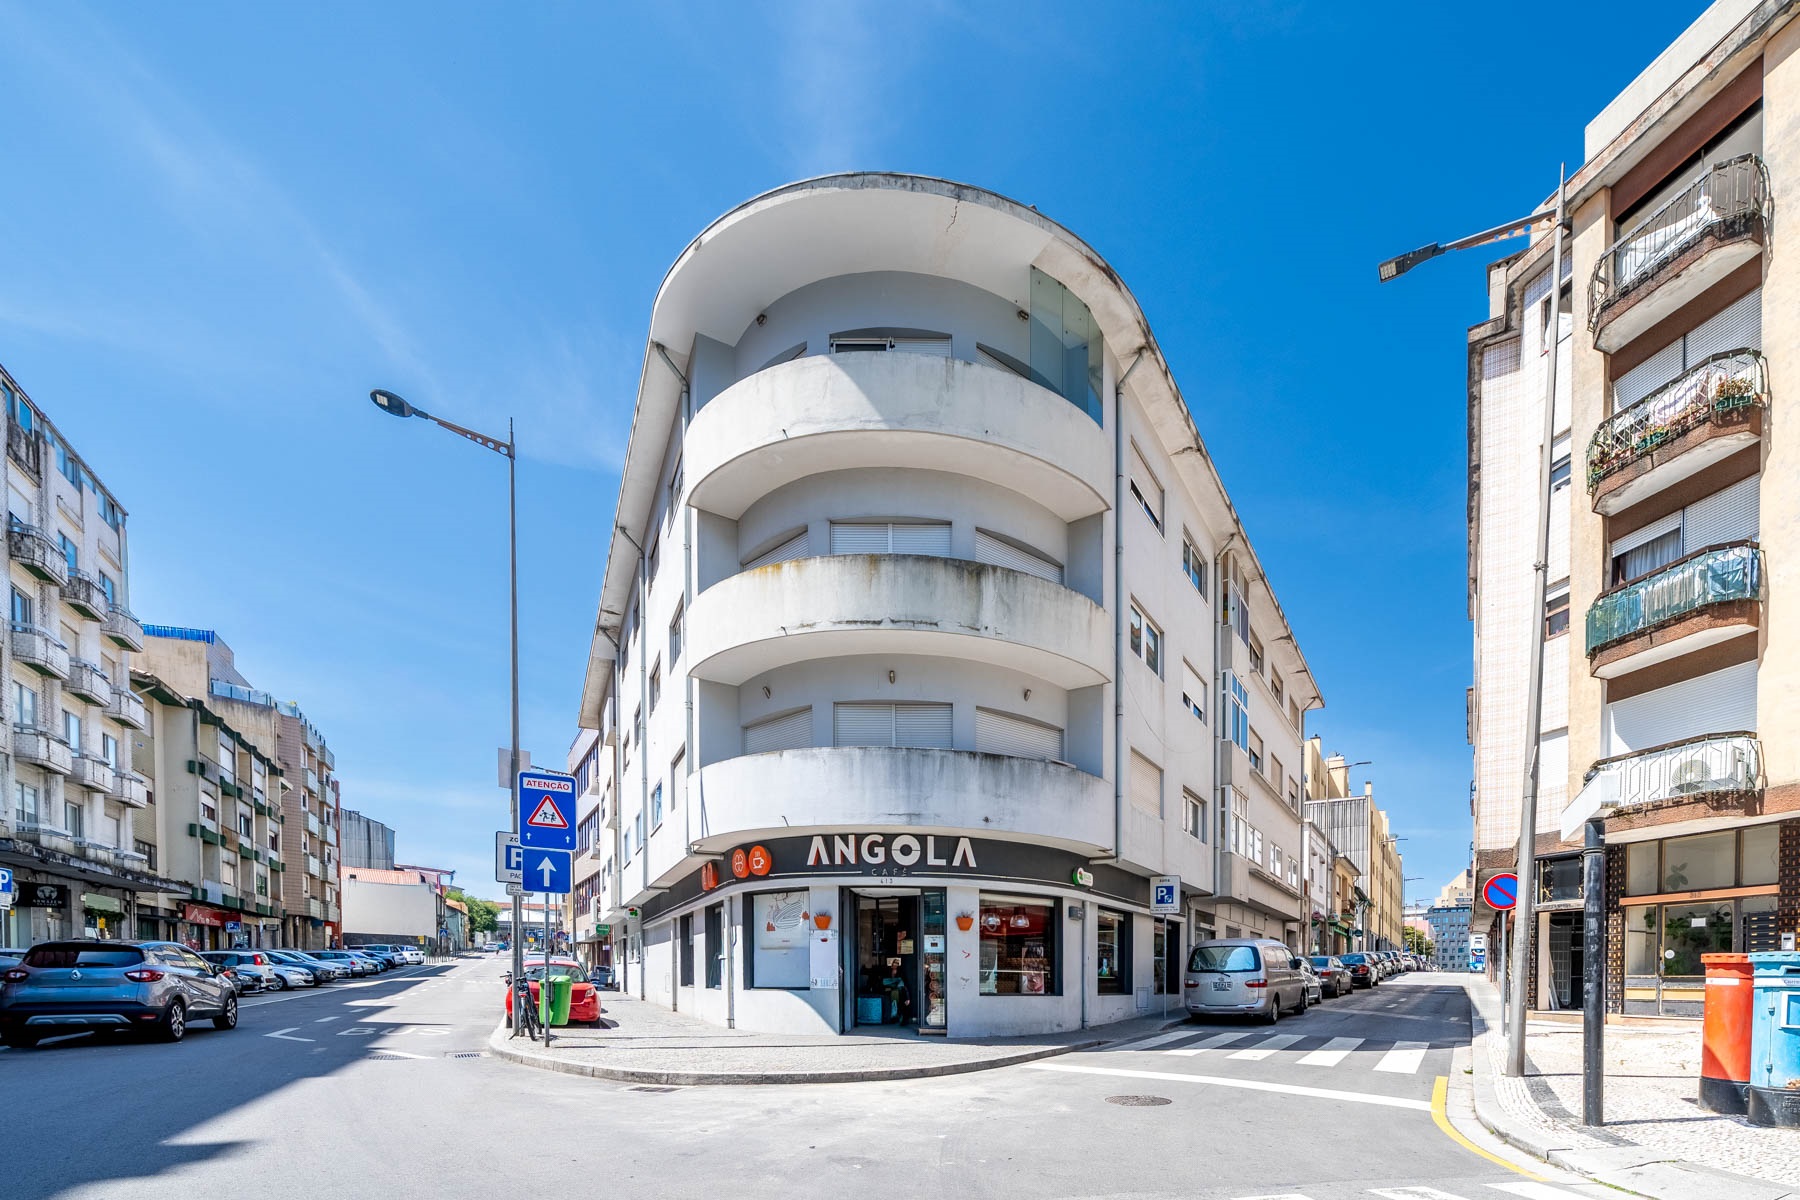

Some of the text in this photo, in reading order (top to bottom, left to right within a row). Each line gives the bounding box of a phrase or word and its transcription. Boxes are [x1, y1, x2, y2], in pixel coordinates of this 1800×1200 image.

[526, 780, 570, 791] ATENÇÃO
[806, 834, 977, 868] ANGOLA
[871, 867, 908, 877] CAFÉ
[0, 869, 9, 891] P
[1157, 887, 1167, 900] P
[336, 1027, 453, 1036] BUS
